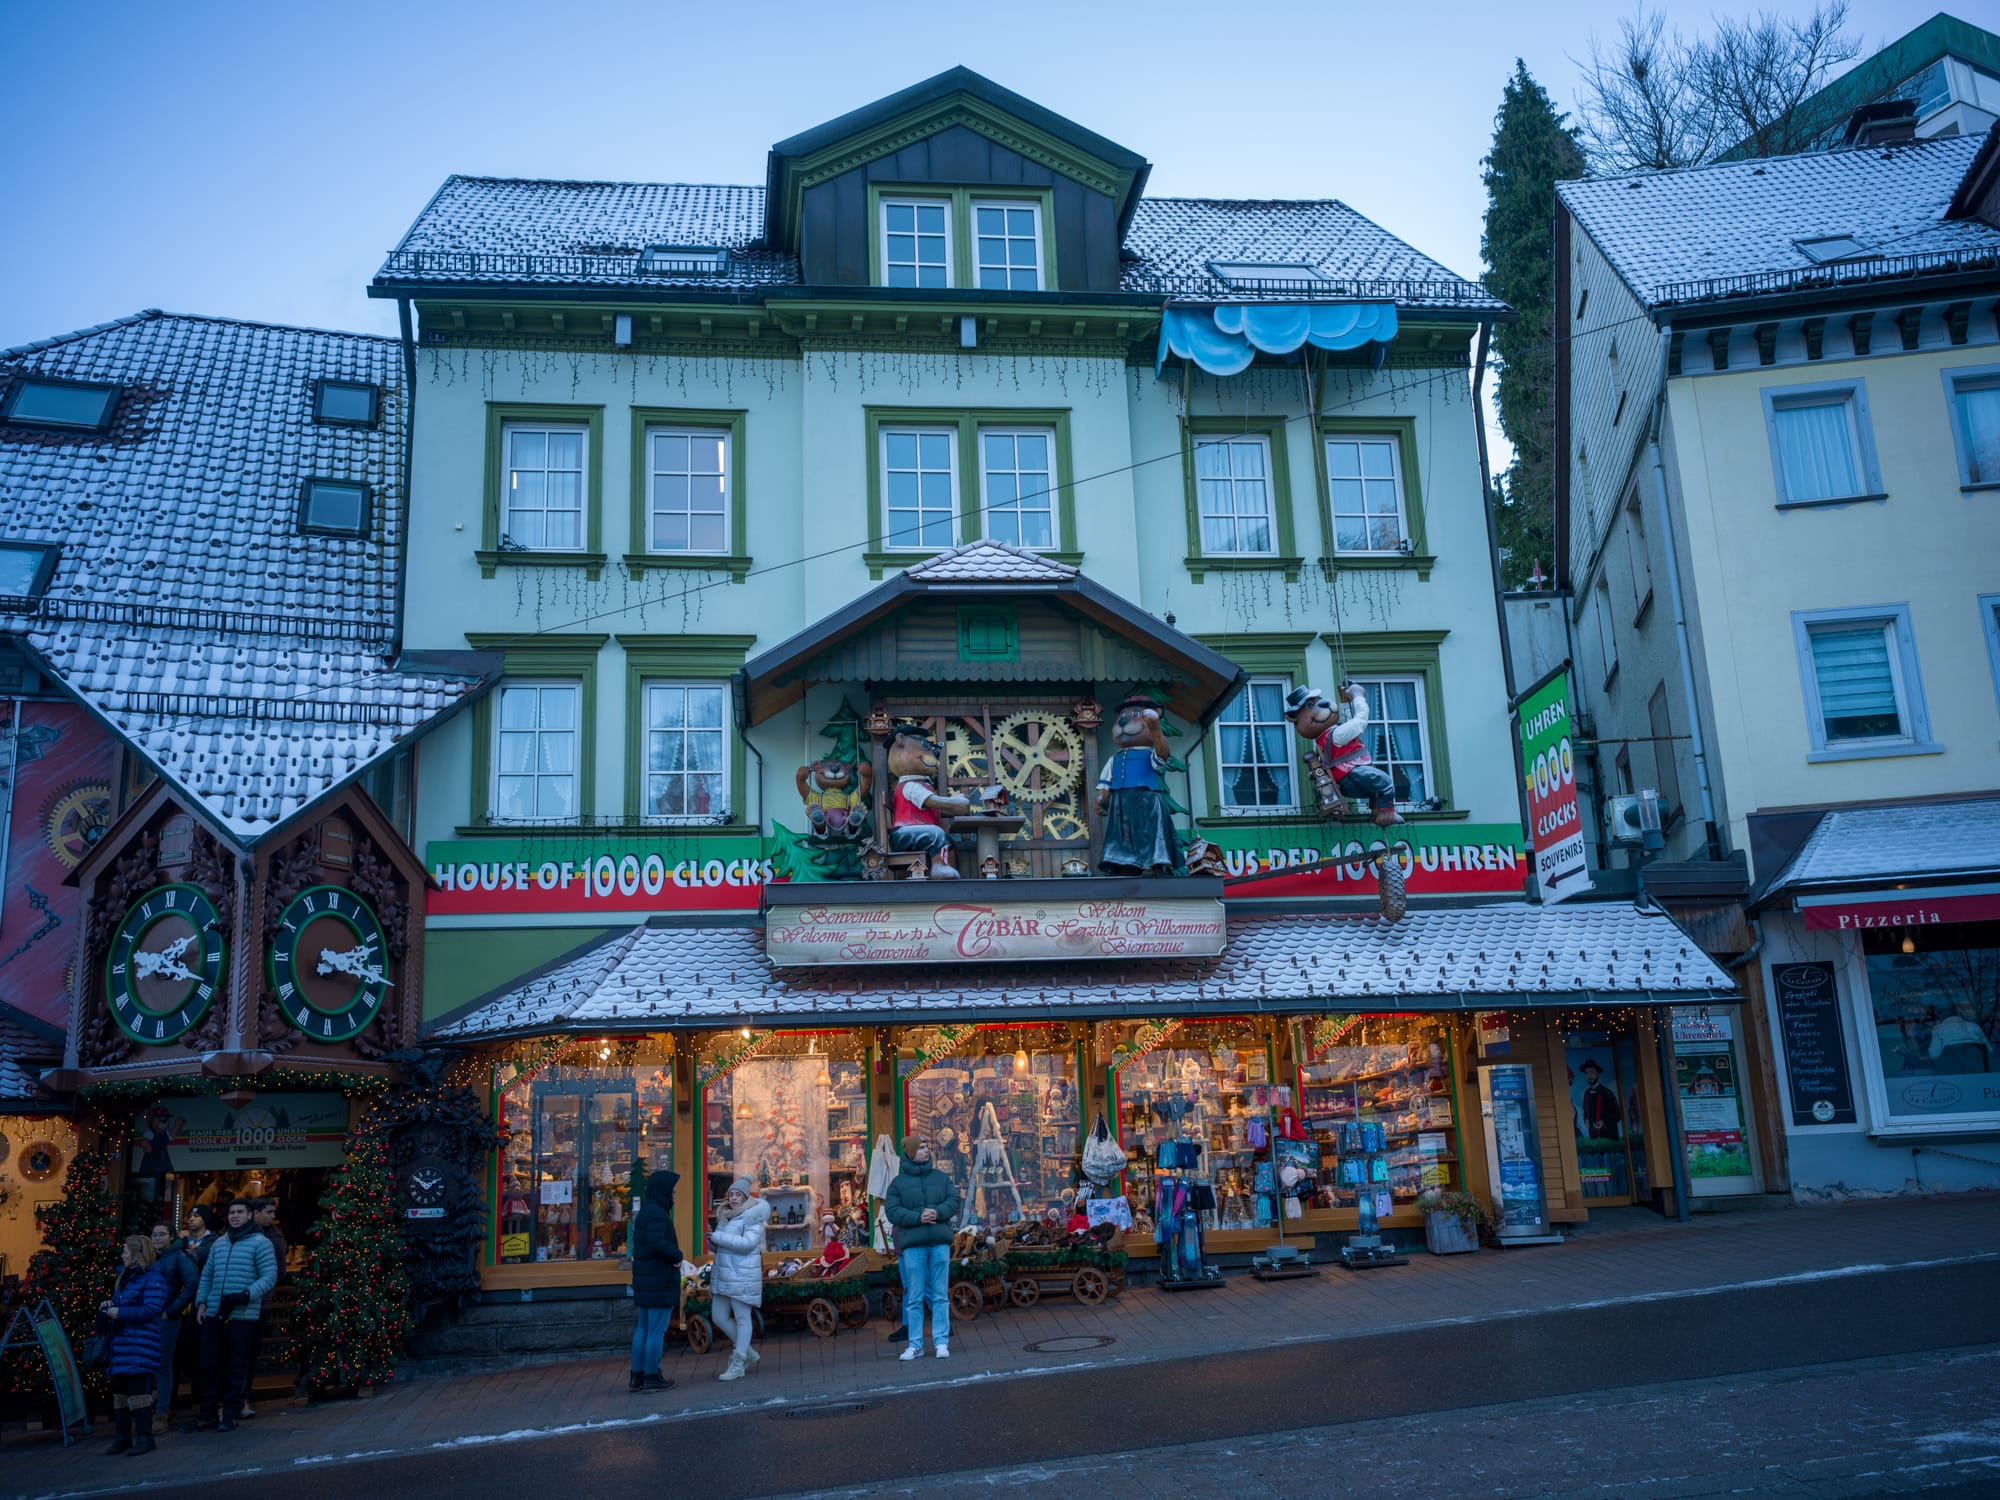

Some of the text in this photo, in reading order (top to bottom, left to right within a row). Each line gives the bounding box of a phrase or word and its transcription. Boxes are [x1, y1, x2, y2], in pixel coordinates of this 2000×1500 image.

[1526, 698, 1566, 740] UHREN
[1530, 737, 1573, 804] 1000
[1537, 800, 1577, 837] CLOCKS
[1226, 840, 1518, 881] US DER 1000 UHREN
[1541, 840, 1583, 872] SOUVENIRS
[435, 855, 776, 898] HOUSE OF 1000 CLOCKS
[799, 906, 890, 924] Benvenuto
[1078, 901, 1146, 918] Welkom
[1838, 909, 1940, 928] Pizzeria
[771, 926, 847, 944] Welcome
[866, 928, 938, 942] ウエルカム
[1045, 919, 1222, 937] Herzlich Willkommen
[840, 943, 929, 960] Bienvenido
[1100, 937, 1184, 953] Bienvenue
[1141, 1031, 1164, 1054] 1000
[1322, 1024, 1346, 1049] 1000
[731, 1045, 757, 1069] 1000
[931, 1039, 956, 1063] 1000
[190, 1128, 214, 1136] HAUS
[235, 1127, 275, 1145] 1000
